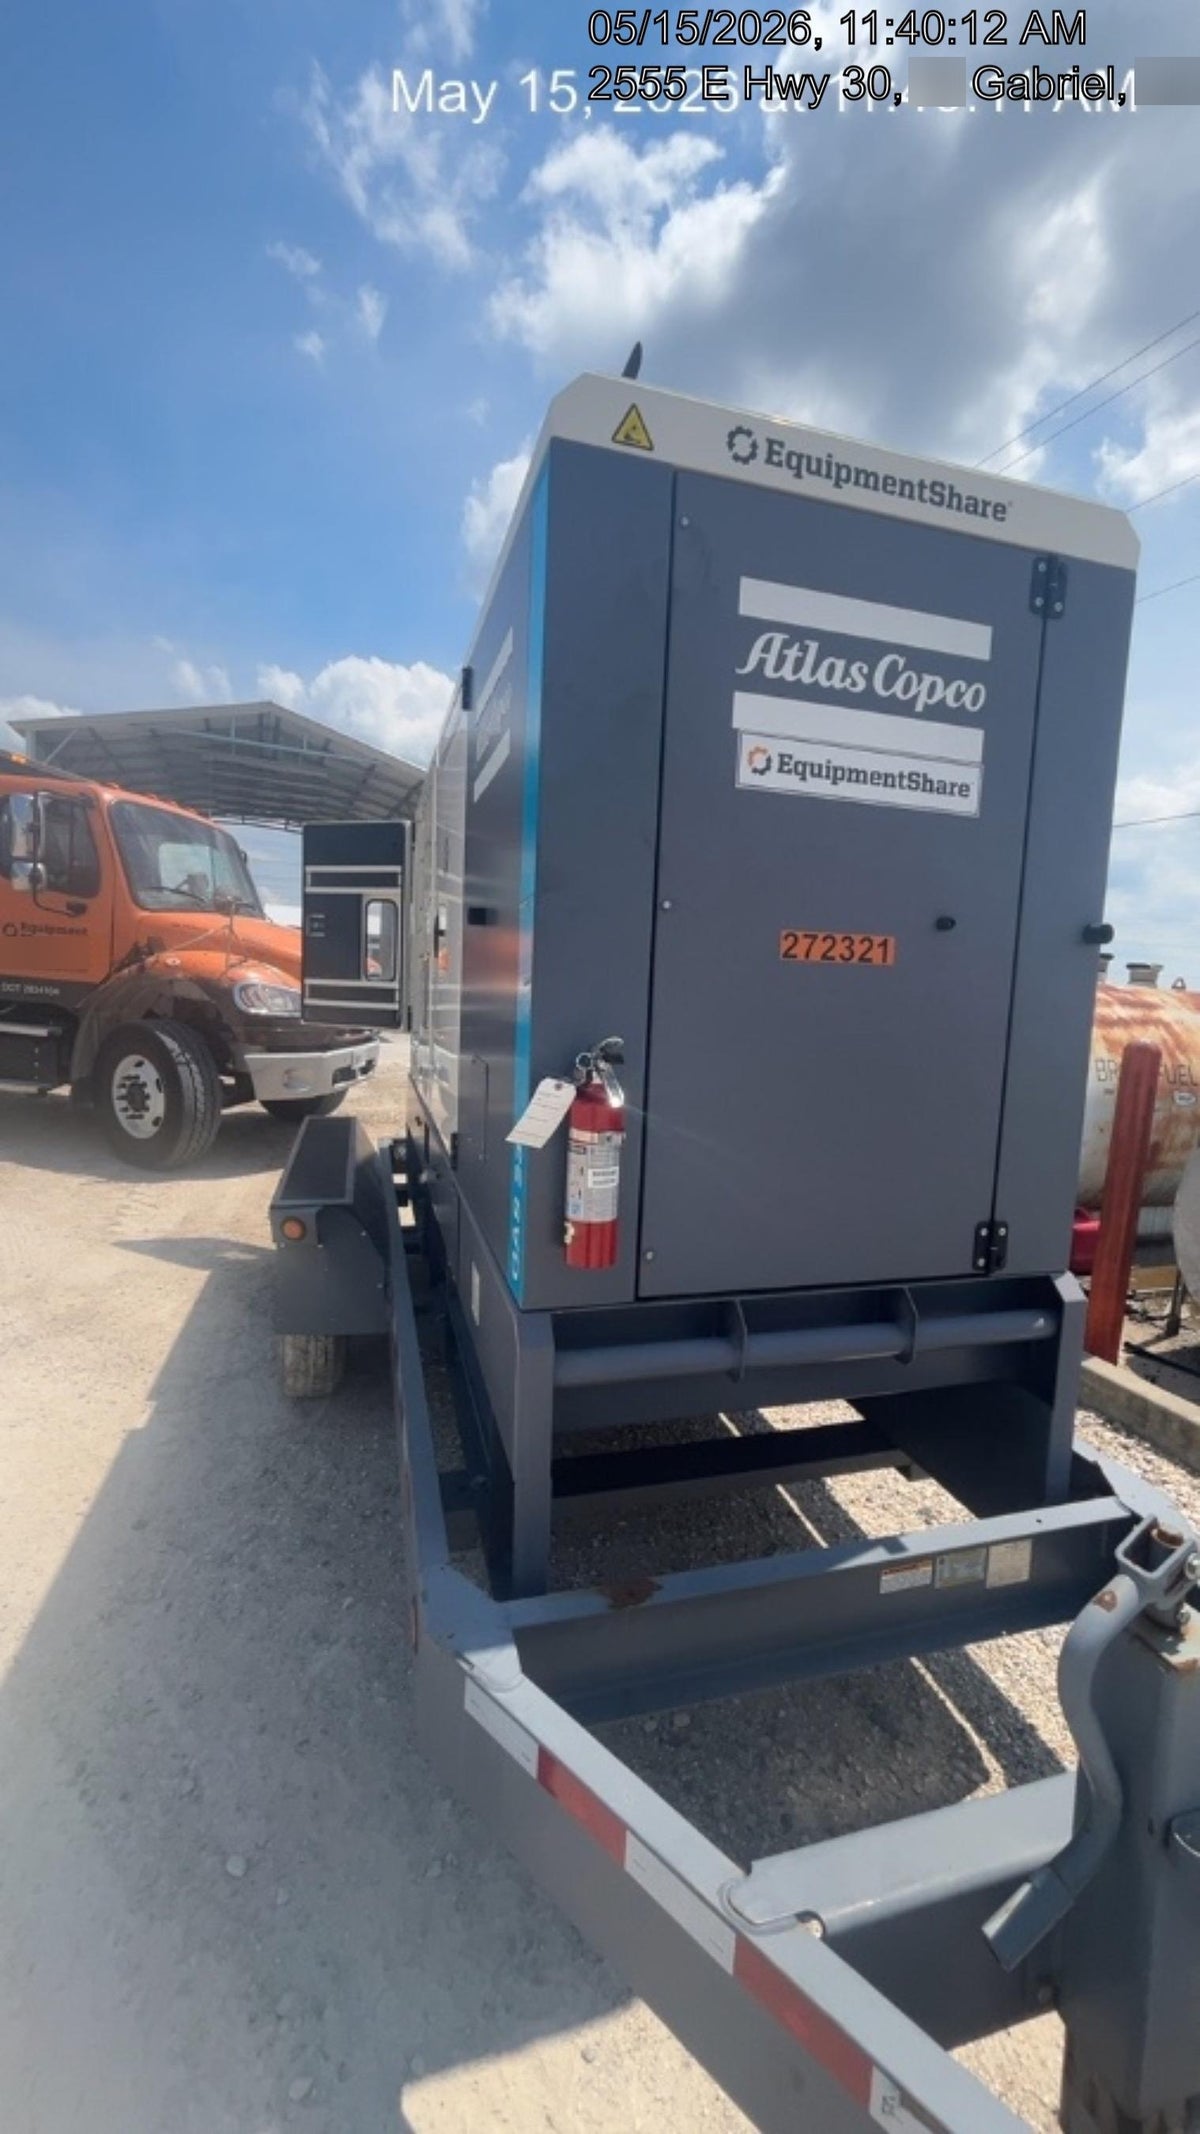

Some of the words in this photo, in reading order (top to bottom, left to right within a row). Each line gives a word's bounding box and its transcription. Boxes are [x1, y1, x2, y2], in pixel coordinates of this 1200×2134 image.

[764, 438, 1008, 522] EquipmentShare
[735, 632, 869, 693] Atlas
[873, 653, 986, 713] Copco
[777, 753, 971, 798] EquipmentShare
[782, 932, 888, 963] 272321
